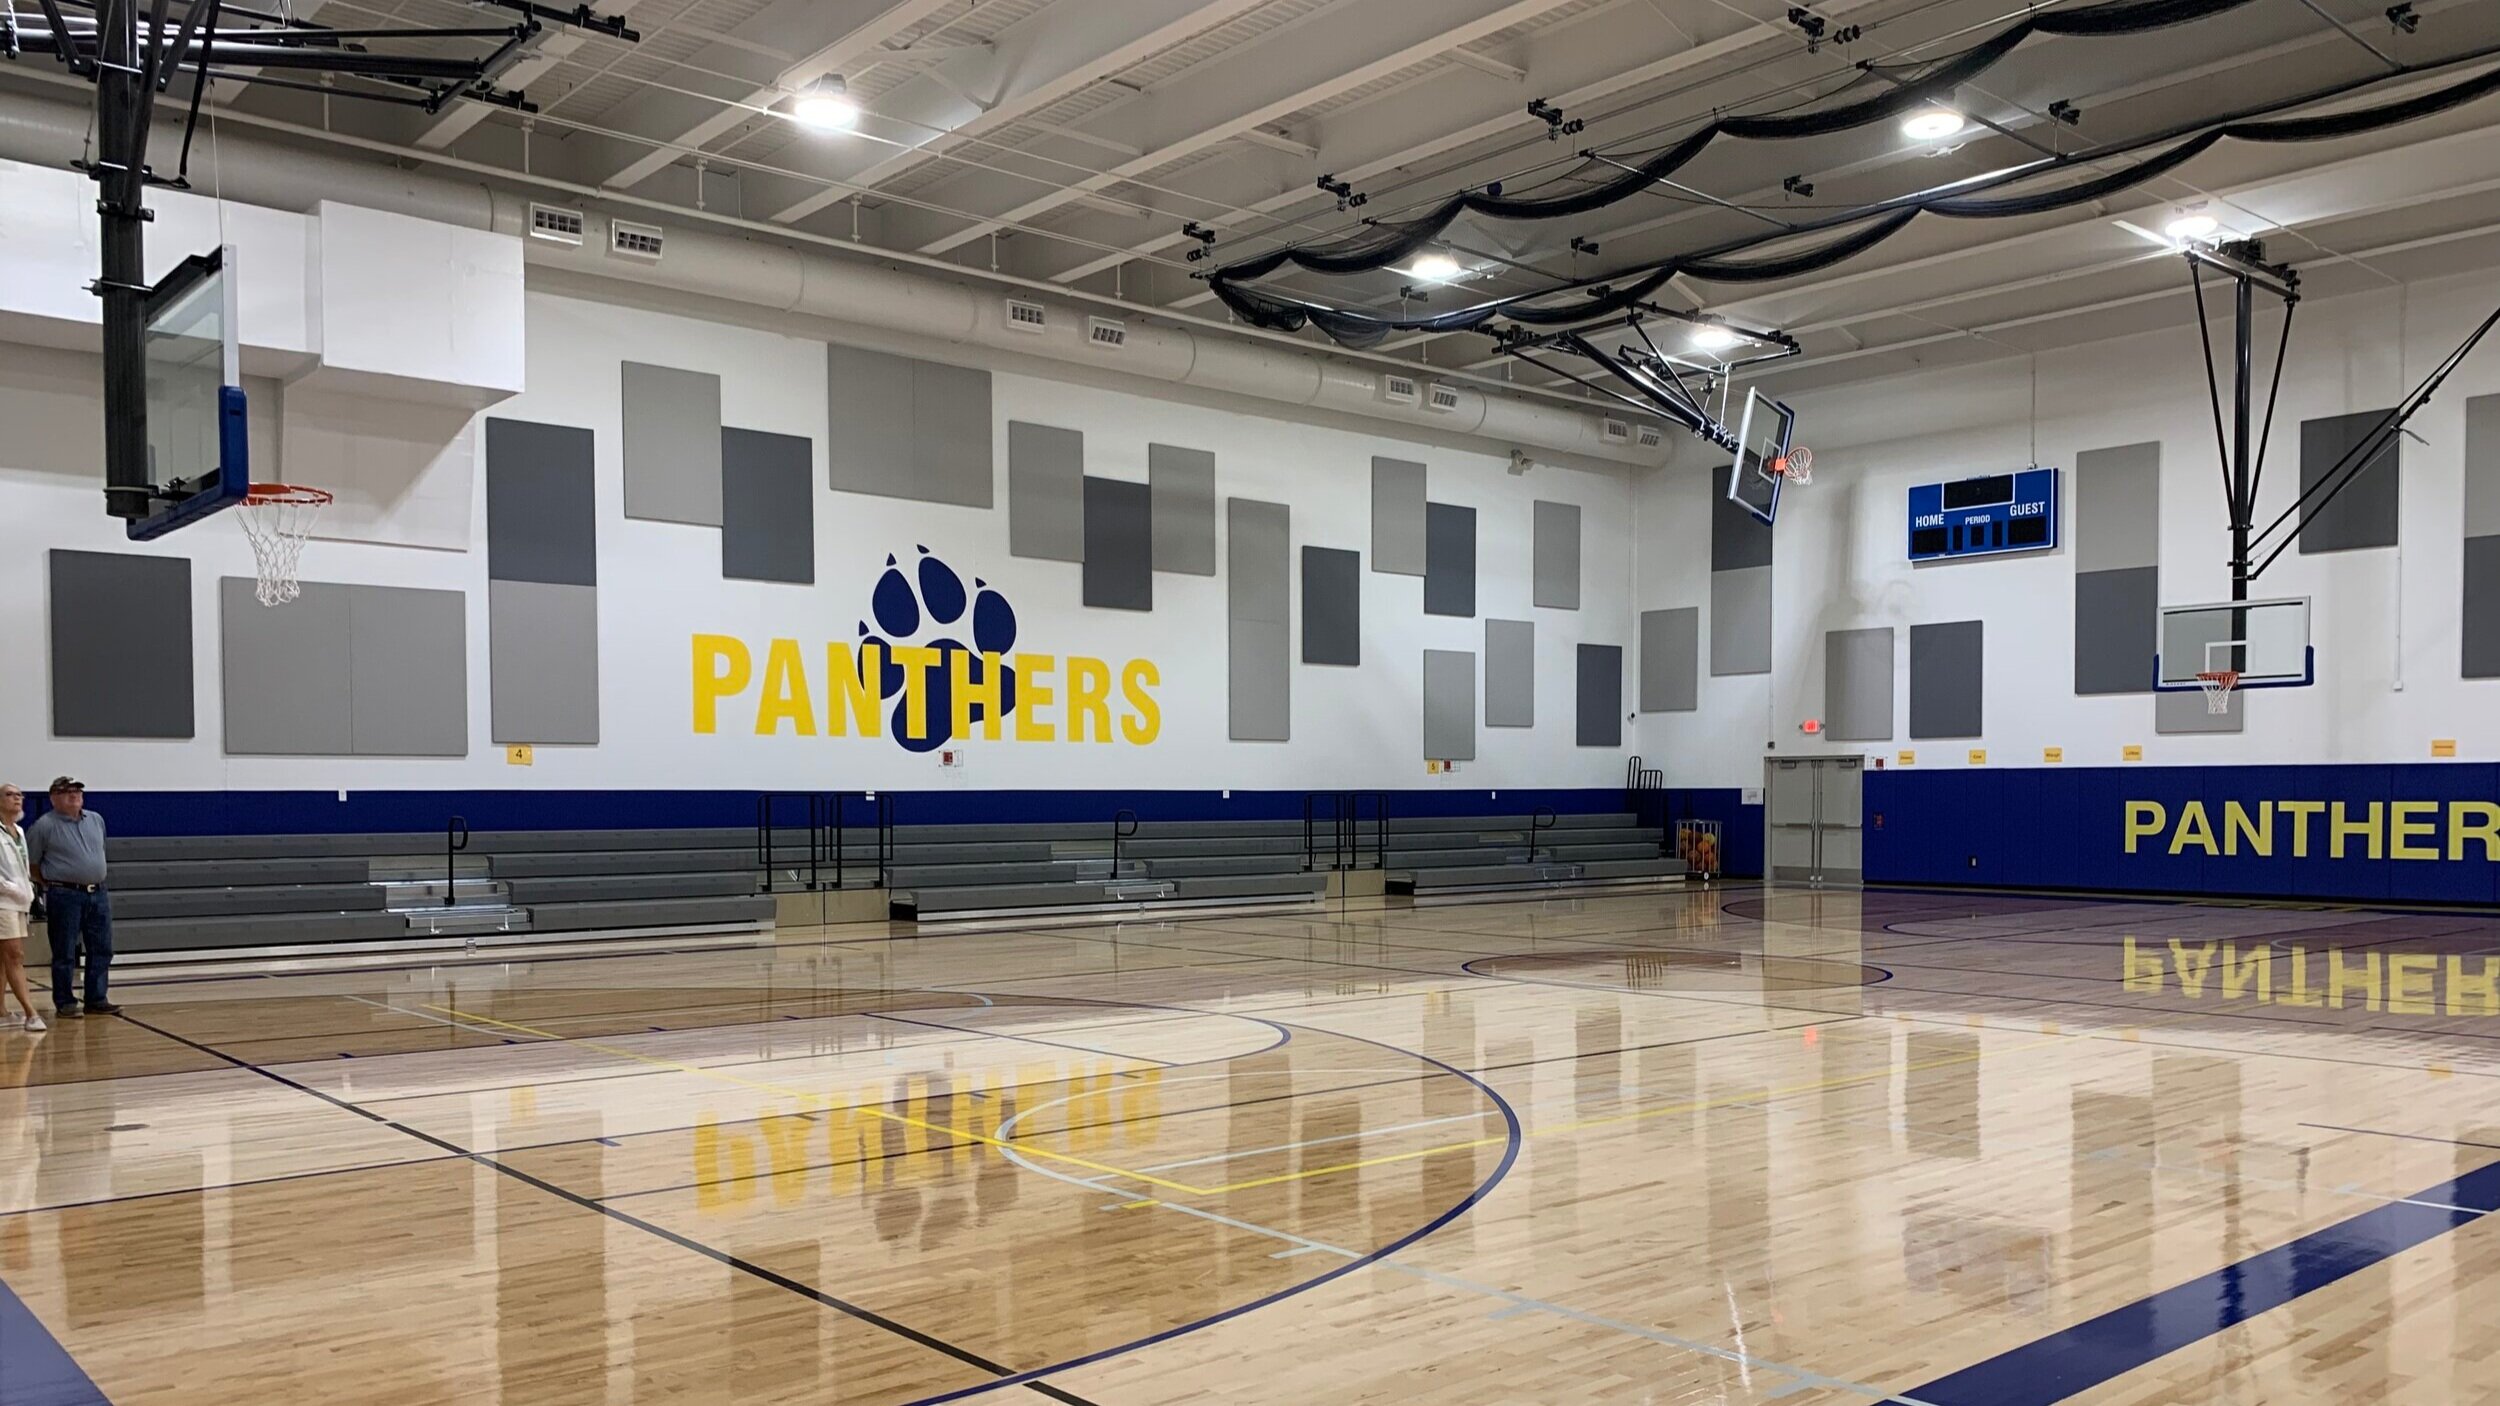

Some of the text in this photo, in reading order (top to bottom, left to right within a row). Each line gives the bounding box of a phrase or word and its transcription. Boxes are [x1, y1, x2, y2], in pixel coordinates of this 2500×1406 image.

[2009, 501, 2046, 517] GUEST
[1915, 513, 1945, 528] HOME
[1965, 514, 1991, 525] PERIOD
[692, 633, 1161, 746] PANTHERS
[515, 748, 523, 759] 4
[2124, 800, 2500, 861] PANTHER
